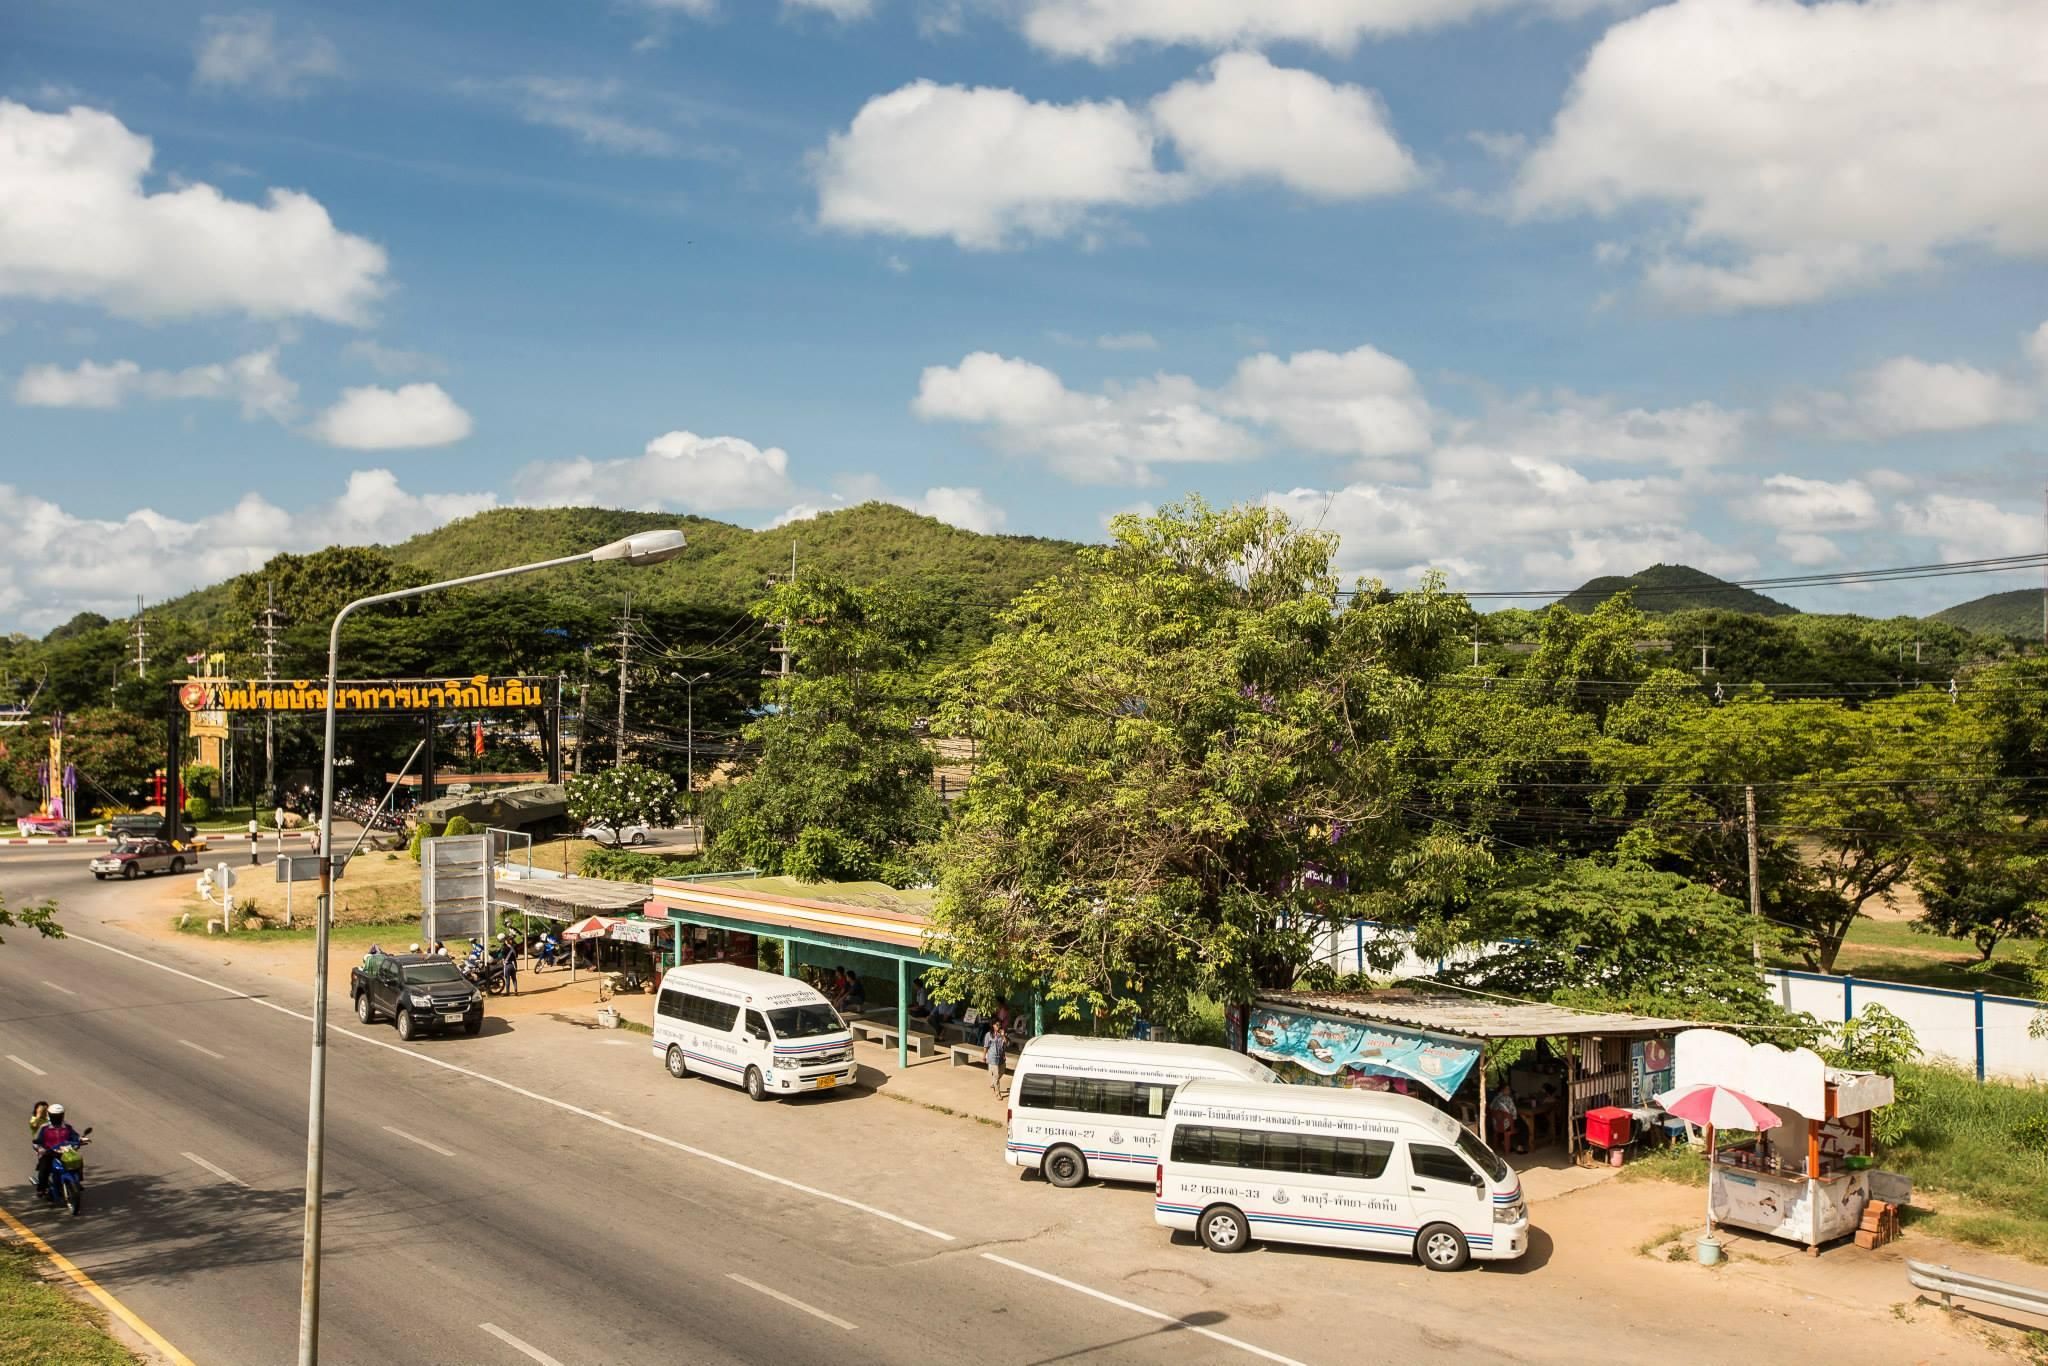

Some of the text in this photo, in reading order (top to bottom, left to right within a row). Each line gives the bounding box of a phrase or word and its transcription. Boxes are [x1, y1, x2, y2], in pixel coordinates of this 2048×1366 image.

[223, 675, 542, 710] หน่วยบัญชาการนาวิกโยธิน
